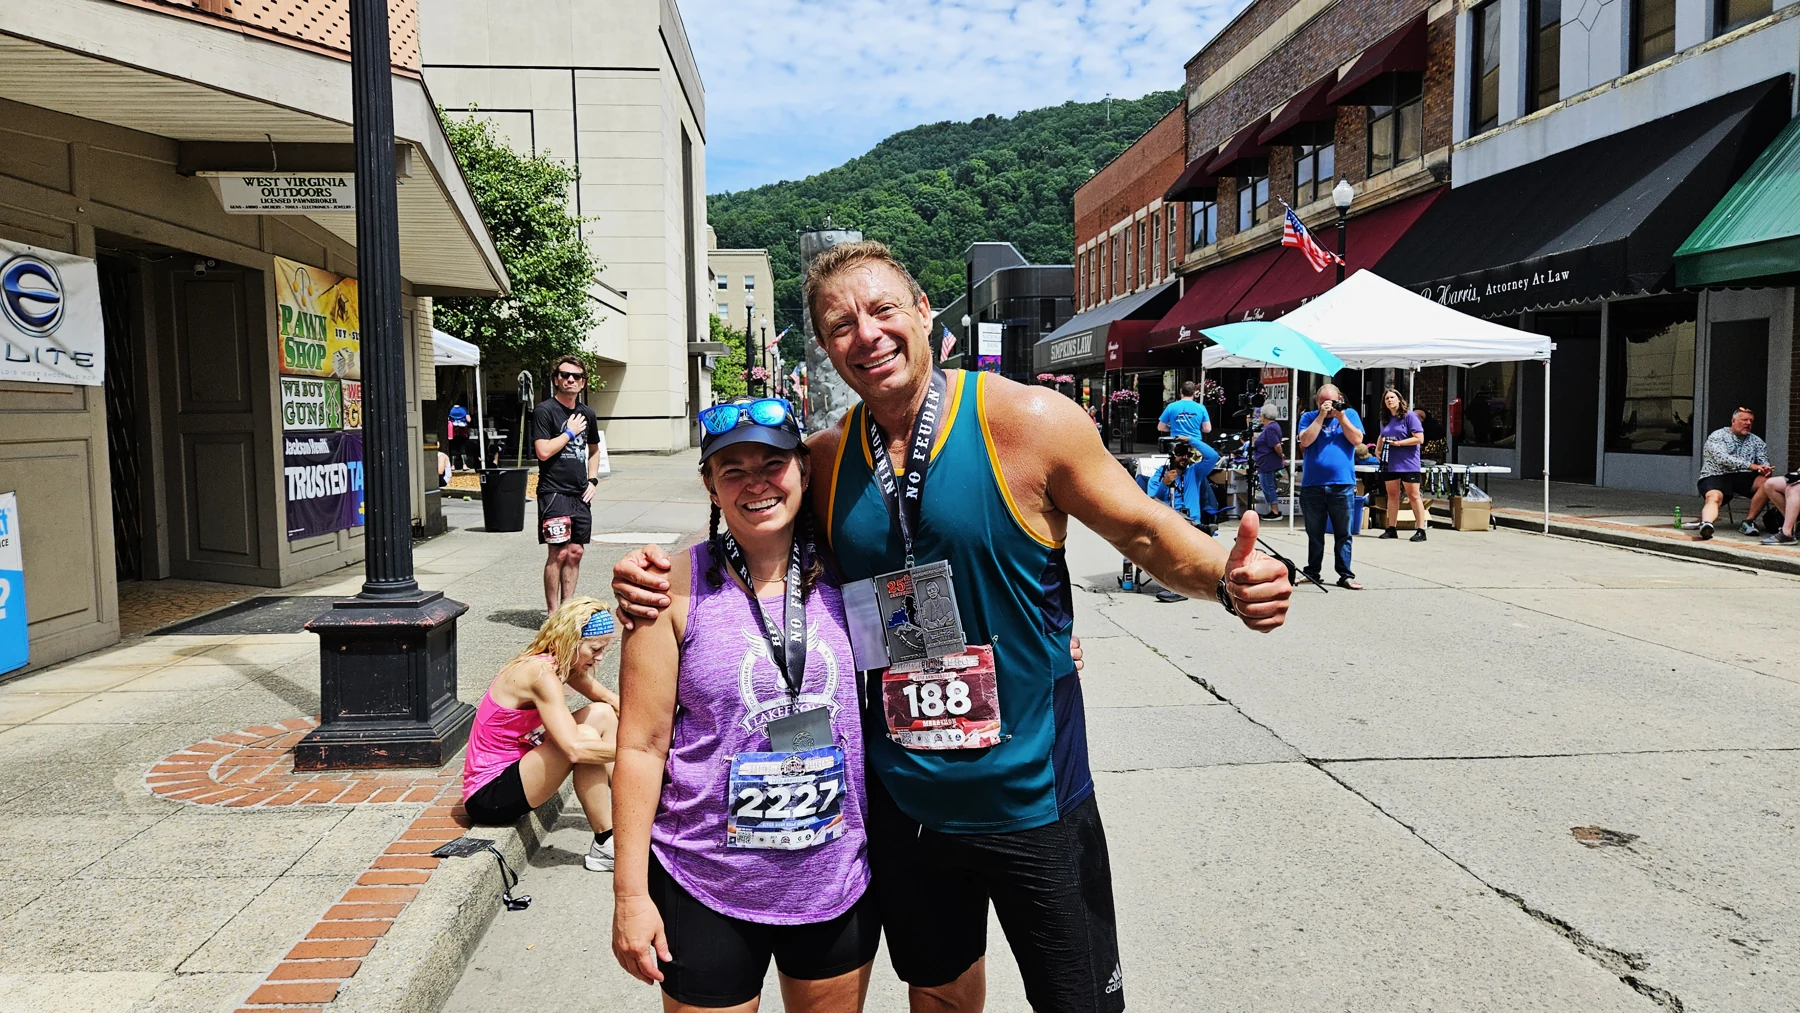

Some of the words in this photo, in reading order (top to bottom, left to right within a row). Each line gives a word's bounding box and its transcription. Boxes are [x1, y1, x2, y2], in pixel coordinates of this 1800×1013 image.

[242, 177, 280, 187] WEST
[284, 177, 348, 187] VIRGINIA
[261, 188, 332, 198] OUTDOORS
[1437, 284, 1481, 306] Harris,
[1485, 278, 1529, 296] Attorney
[1532, 272, 1545, 286] At
[1548, 269, 1570, 283] Law
[279, 303, 328, 342] PAWN
[285, 337, 327, 371] SHOP
[1050, 338, 1077, 361] SIMPKINS
[1076, 334, 1093, 355] LAW
[282, 379, 300, 398] WE
[302, 381, 323, 398] BUY
[284, 462, 348, 501] TRUSTED
[347, 460, 364, 492] TA
[906, 471, 921, 500] NO
[547, 525, 567, 536] 183
[724, 529, 740, 560] UST
[790, 618, 803, 644] NO
[902, 680, 972, 718] 188
[736, 778, 839, 819] 2227
